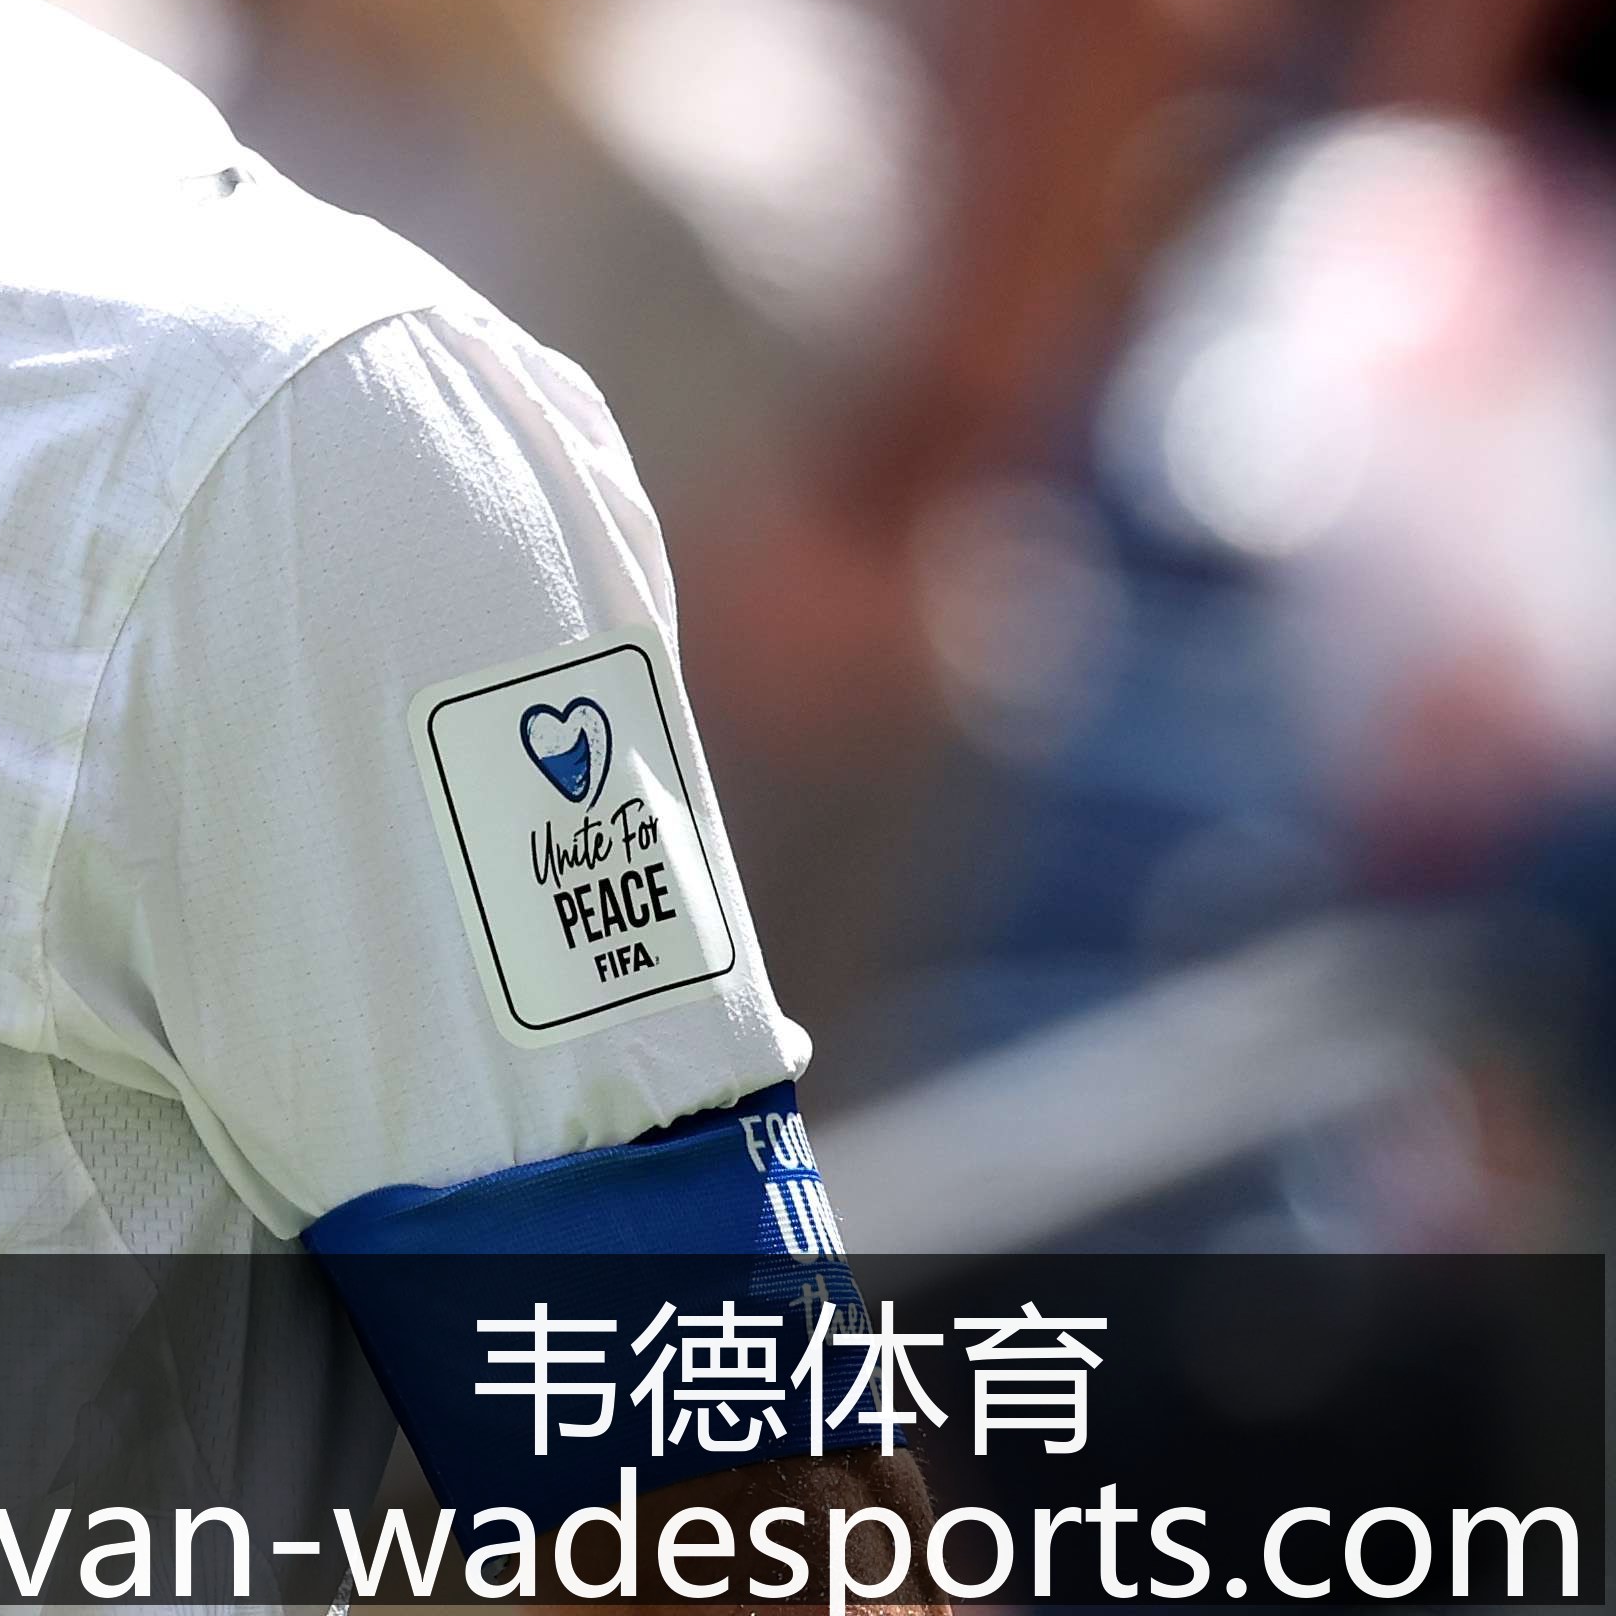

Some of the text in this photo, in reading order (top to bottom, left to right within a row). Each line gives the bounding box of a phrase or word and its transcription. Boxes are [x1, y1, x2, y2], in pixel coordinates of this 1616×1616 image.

[531, 798, 658, 889] Unite For
[553, 862, 677, 949] PEACE
[594, 942, 655, 983] FIFA
